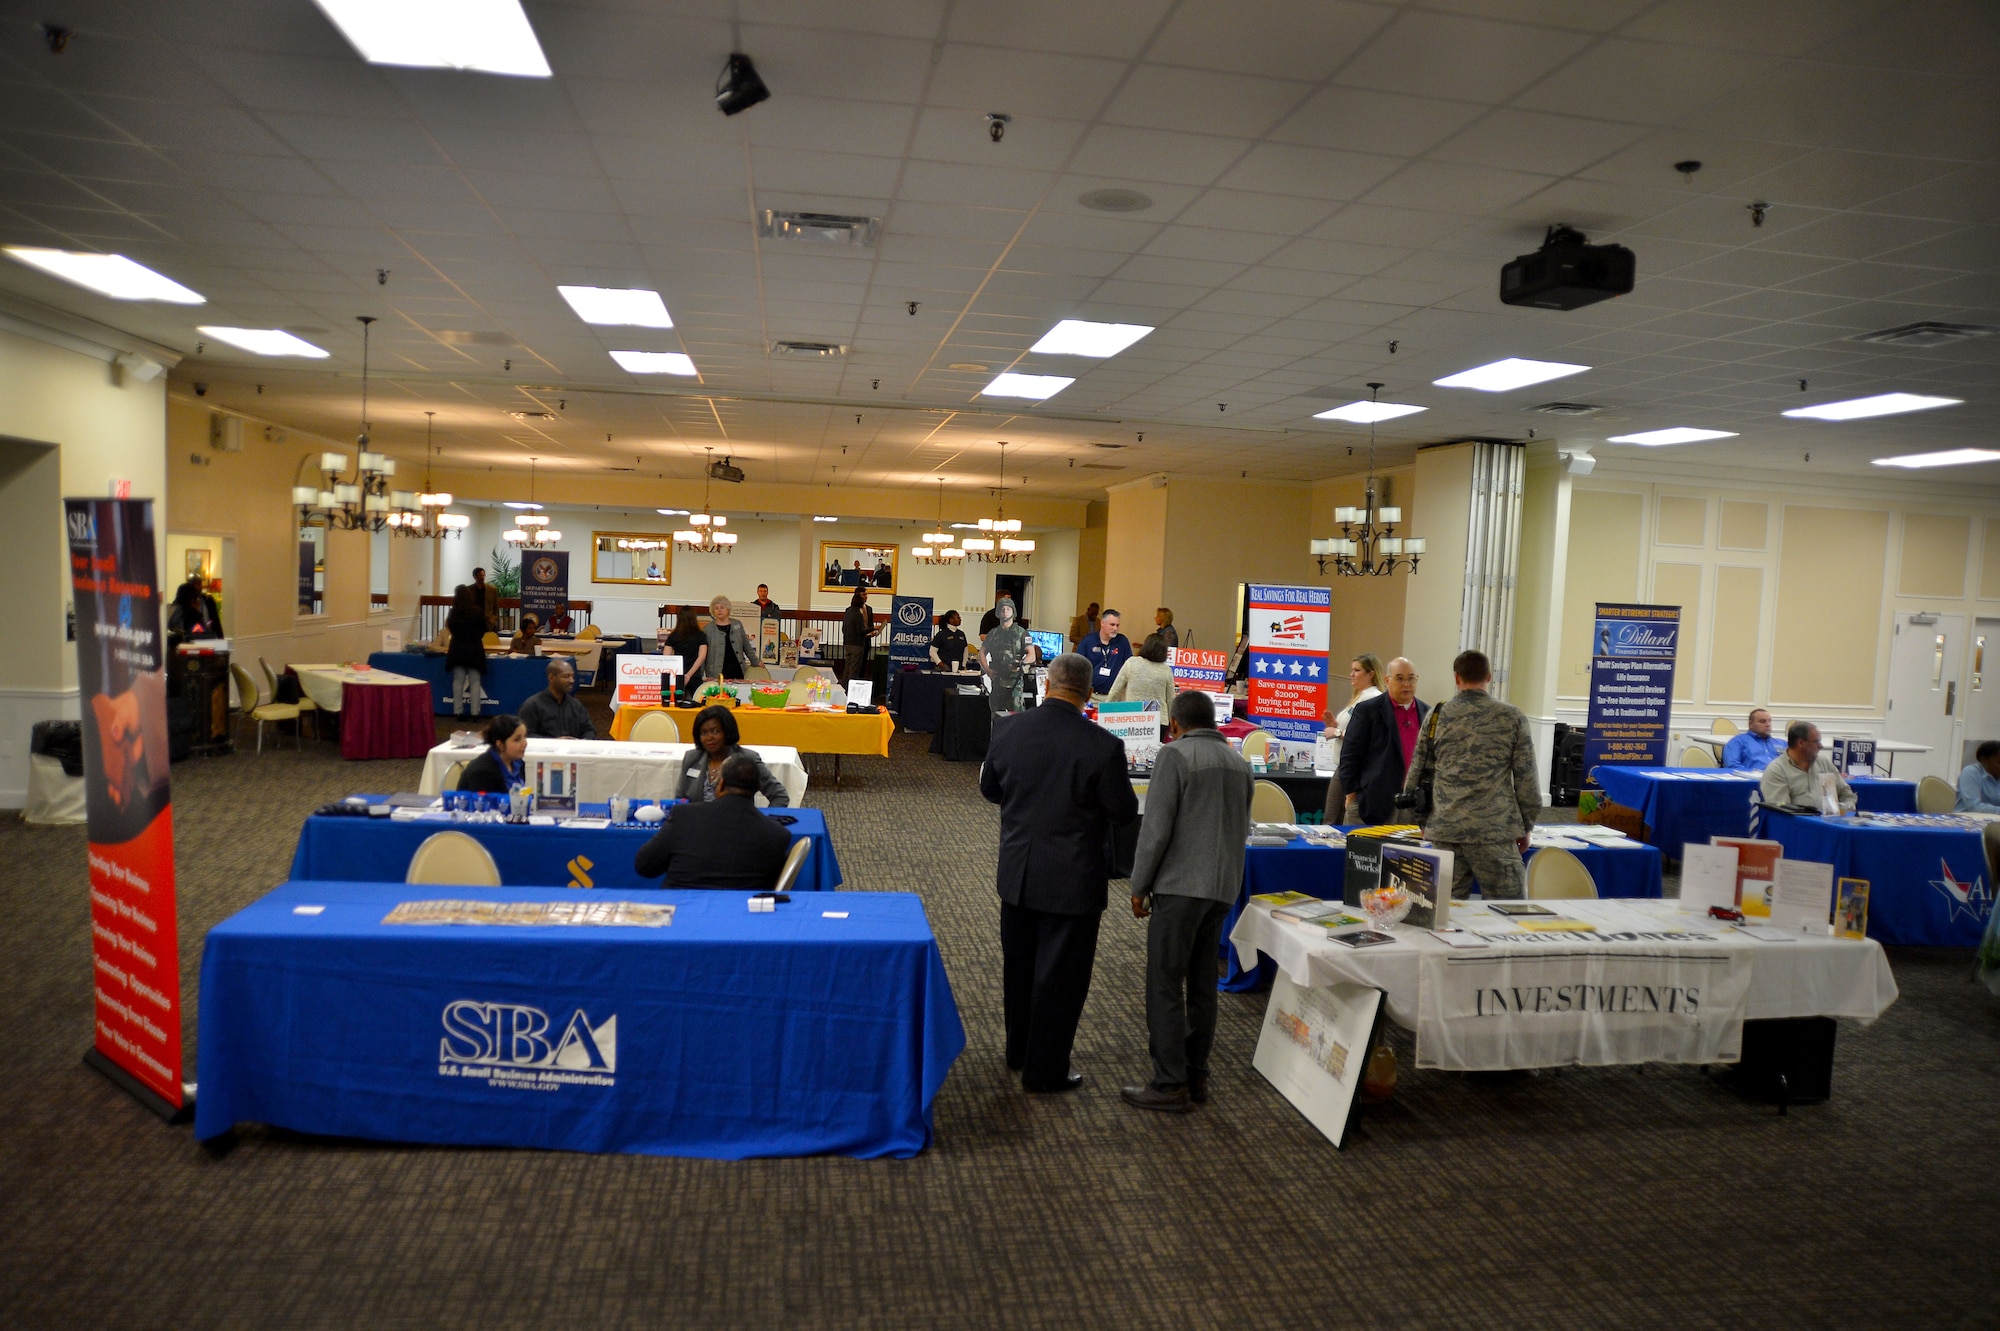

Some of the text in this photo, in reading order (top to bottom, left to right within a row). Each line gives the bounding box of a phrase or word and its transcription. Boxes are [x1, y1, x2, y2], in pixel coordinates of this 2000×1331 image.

[68, 512, 97, 541] SBA
[1251, 588, 1330, 604] REAL SAVINGS FOR REAL HEROES
[1598, 607, 1679, 619] SMARTER RETIREMENT STRATEGIES
[893, 632, 928, 643] Allstate
[1616, 624, 1676, 645] Dillard
[1177, 649, 1199, 665] FOR
[1201, 651, 1226, 667] SALE
[621, 663, 679, 677] Gateway
[1597, 660, 1611, 669] Thrift
[1611, 661, 1631, 671] Savings
[1643, 662, 1672, 671] Alternatives
[1616, 673, 1650, 682] Life Insurance
[1257, 679, 1276, 689] Save
[1287, 684, 1317, 693] average
[1599, 685, 1666, 694] Retirement Benefit Reviews
[1274, 689, 1299, 699] $2000
[1257, 695, 1282, 708] buying
[1292, 699, 1316, 711] selling
[1597, 696, 1666, 706] Tax-Free Retirement Options
[1255, 706, 1316, 718] your next home!
[1602, 708, 1614, 717] Roth
[1620, 708, 1647, 717] Traditional
[1104, 715, 1146, 723] PRE-INSPECTED
[1107, 726, 1155, 737] ouseMaster
[1850, 742, 1873, 752] ENTER
[1856, 752, 1866, 762] TO
[1348, 851, 1378, 863] Financial
[111, 861, 125, 879] Your
[125, 867, 150, 893] Business
[118, 899, 132, 917] Your
[132, 906, 157, 932] Business
[118, 933, 132, 952] Your
[132, 941, 157, 968] Business
[1475, 984, 1700, 1017] INVESTMENTS
[439, 1000, 616, 1074] SBA
[136, 1045, 173, 1081] Government
[438, 1065, 615, 1087] U.S. Small Business Administration
[488, 1079, 560, 1092] WWW.SBA.GOV
